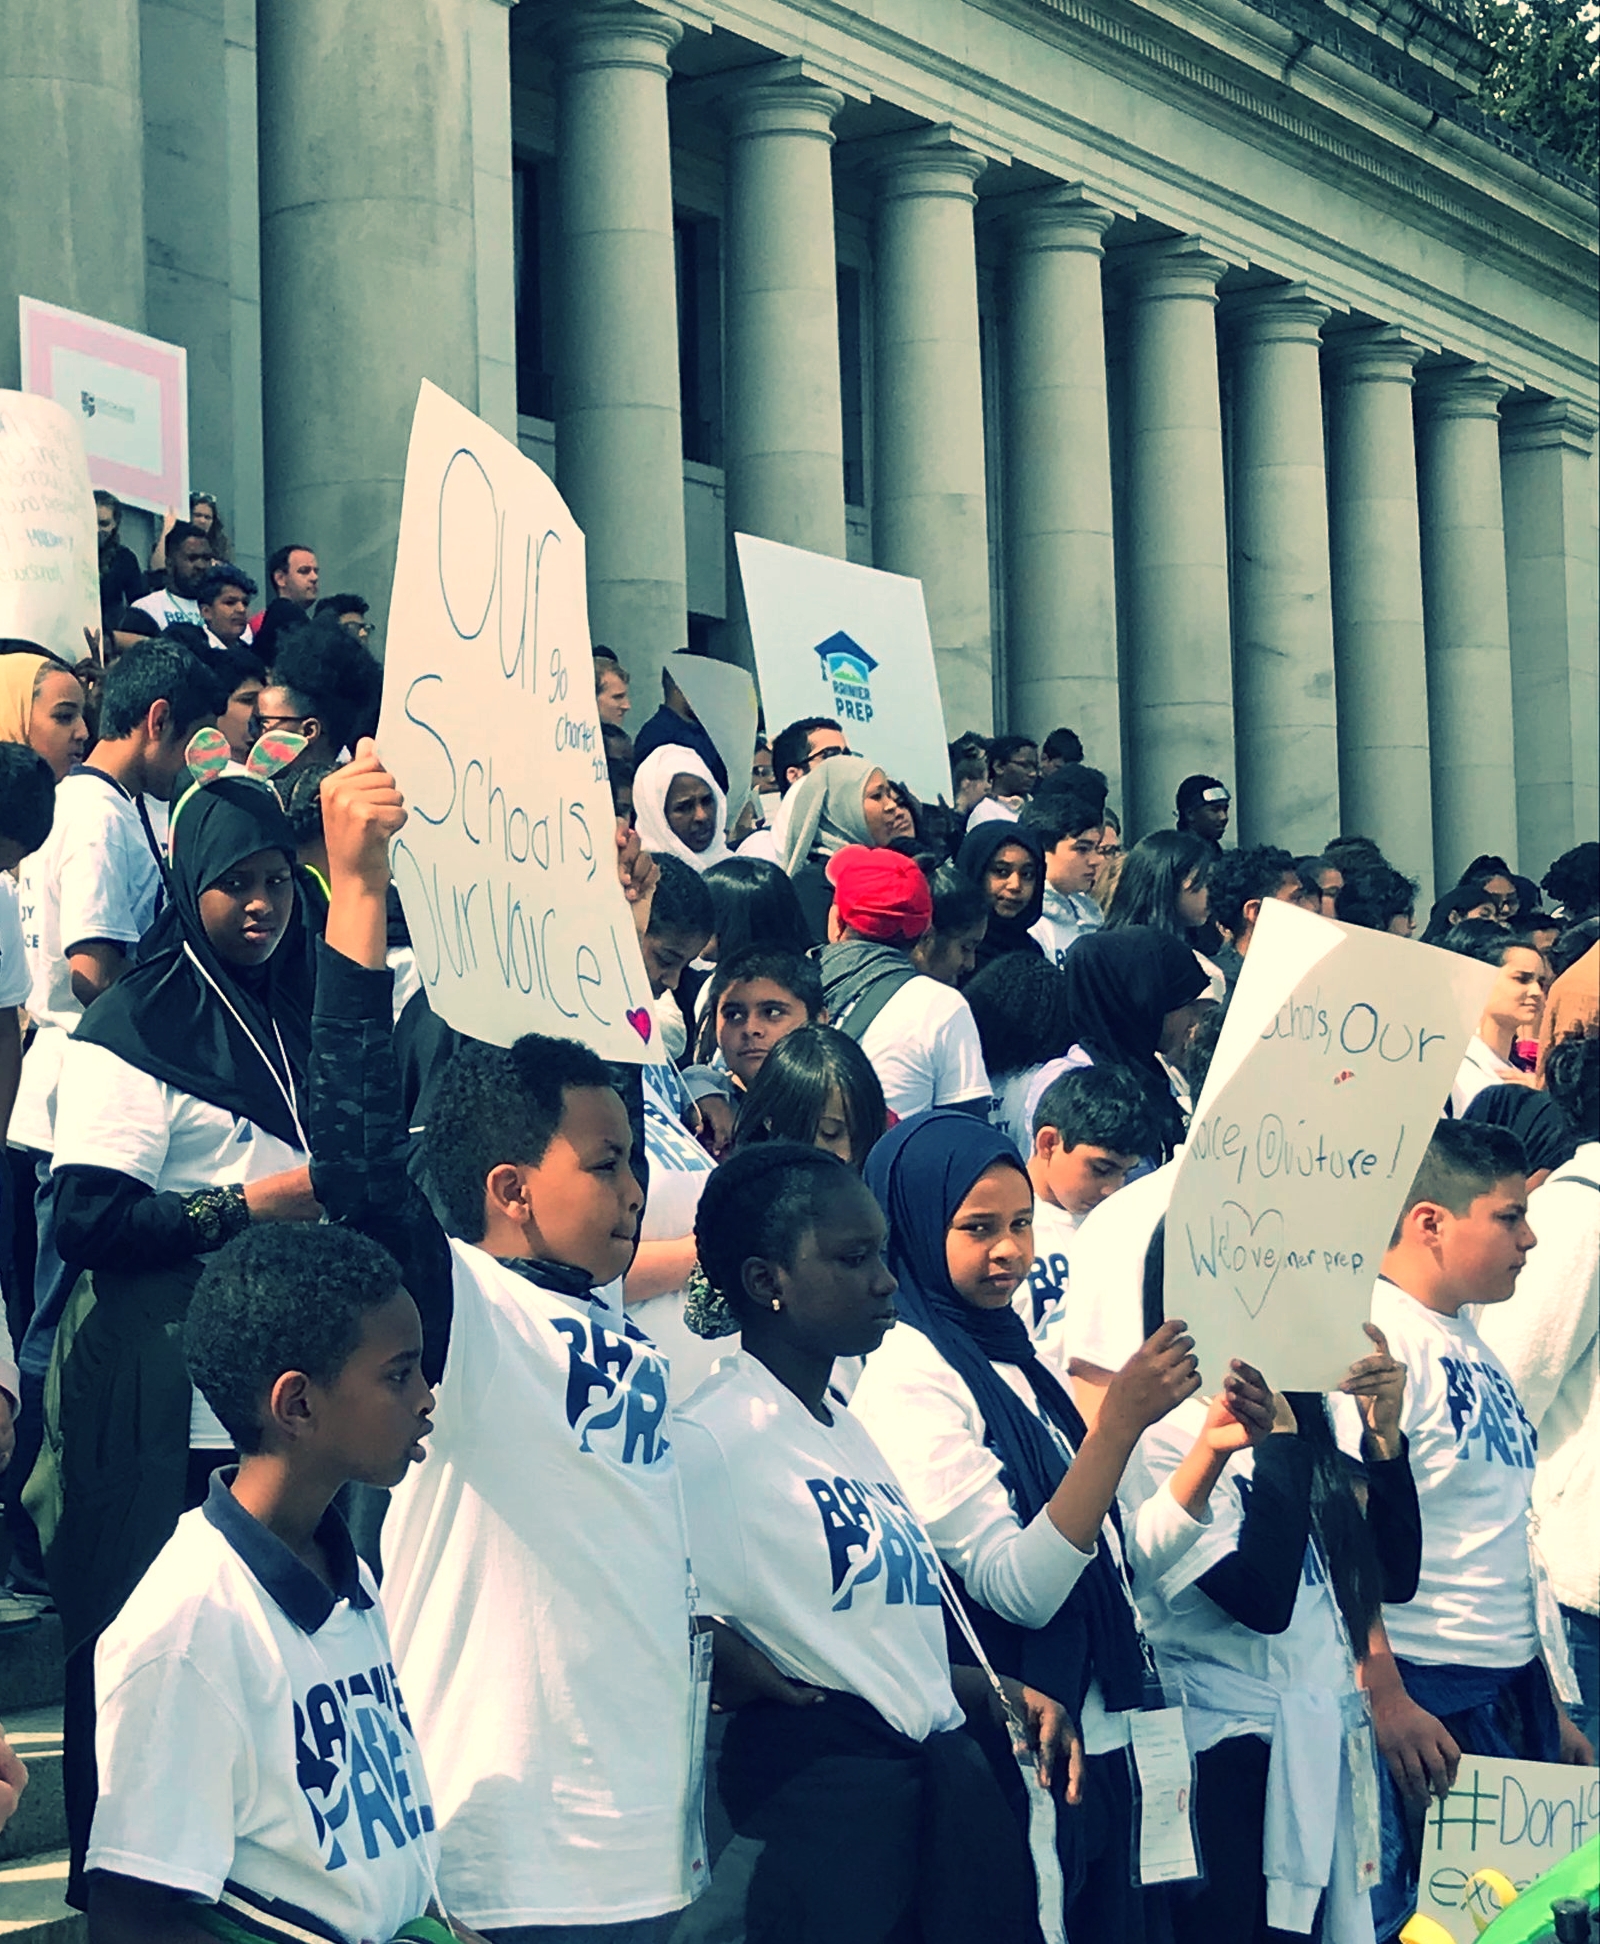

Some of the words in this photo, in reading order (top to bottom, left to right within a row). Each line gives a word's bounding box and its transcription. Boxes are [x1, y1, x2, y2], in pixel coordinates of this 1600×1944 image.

[437, 447, 562, 695] Our
[835, 697, 874, 724] PREP
[1323, 1250, 1364, 1275] prep
